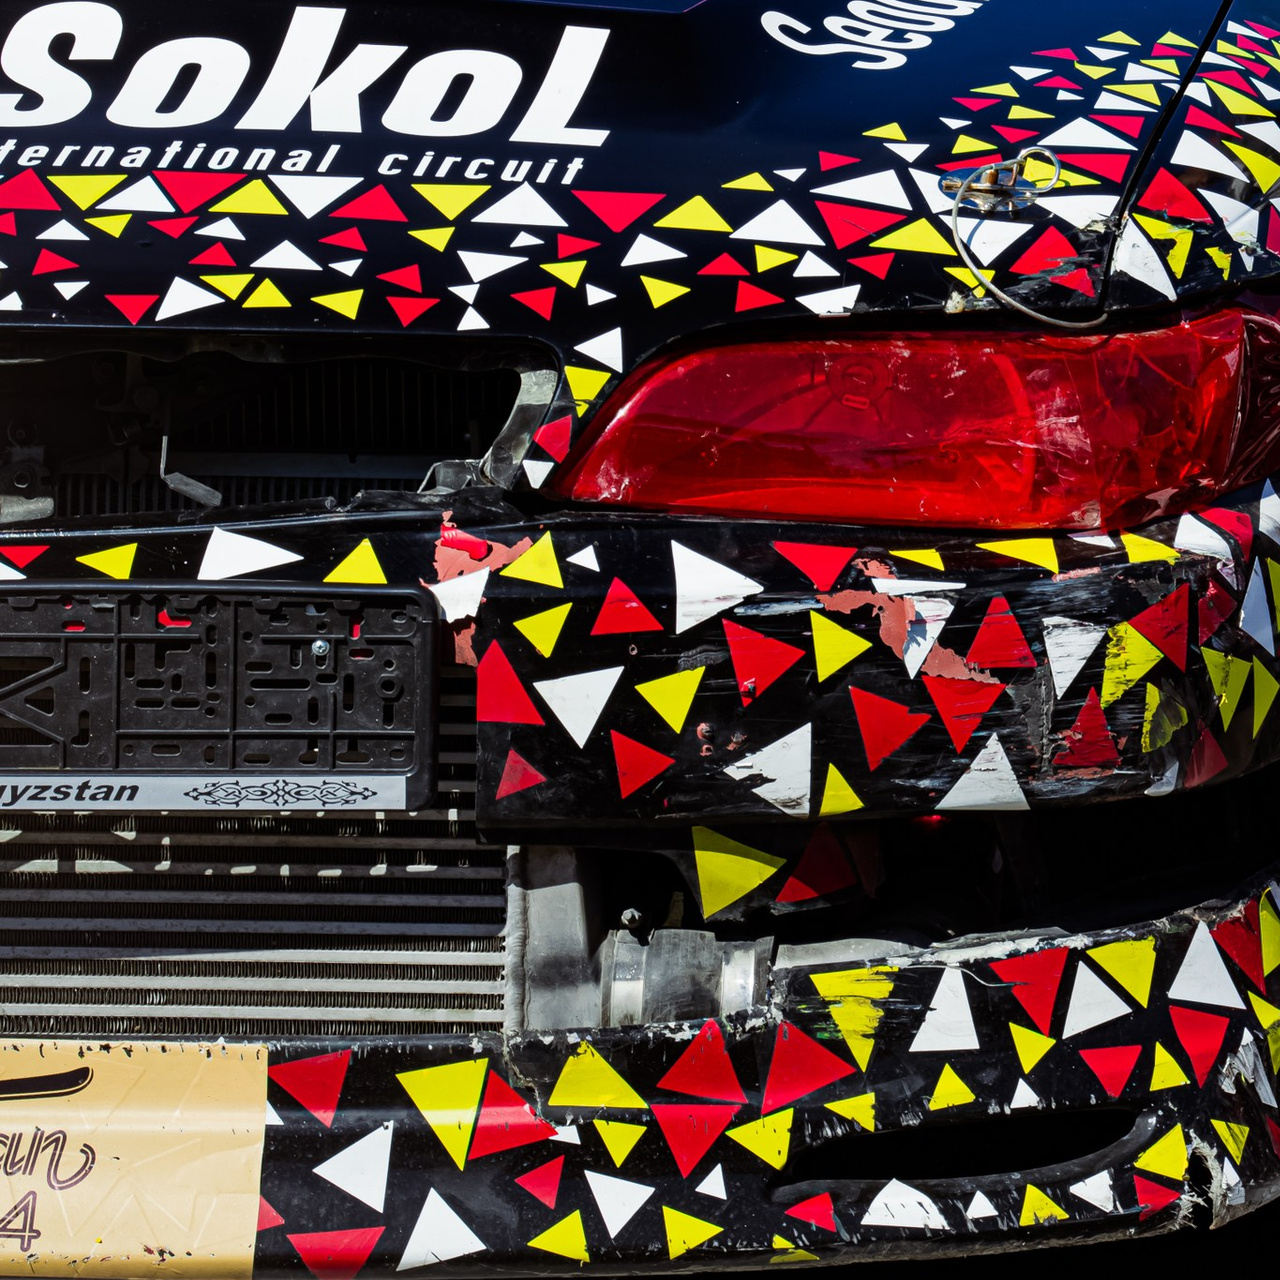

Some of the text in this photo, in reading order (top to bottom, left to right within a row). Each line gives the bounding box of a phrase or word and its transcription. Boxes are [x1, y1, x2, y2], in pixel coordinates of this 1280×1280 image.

[377, 151, 584, 185] circuit
[0, 780, 140, 807] yzstan
[0, 1190, 42, 1252] 4
